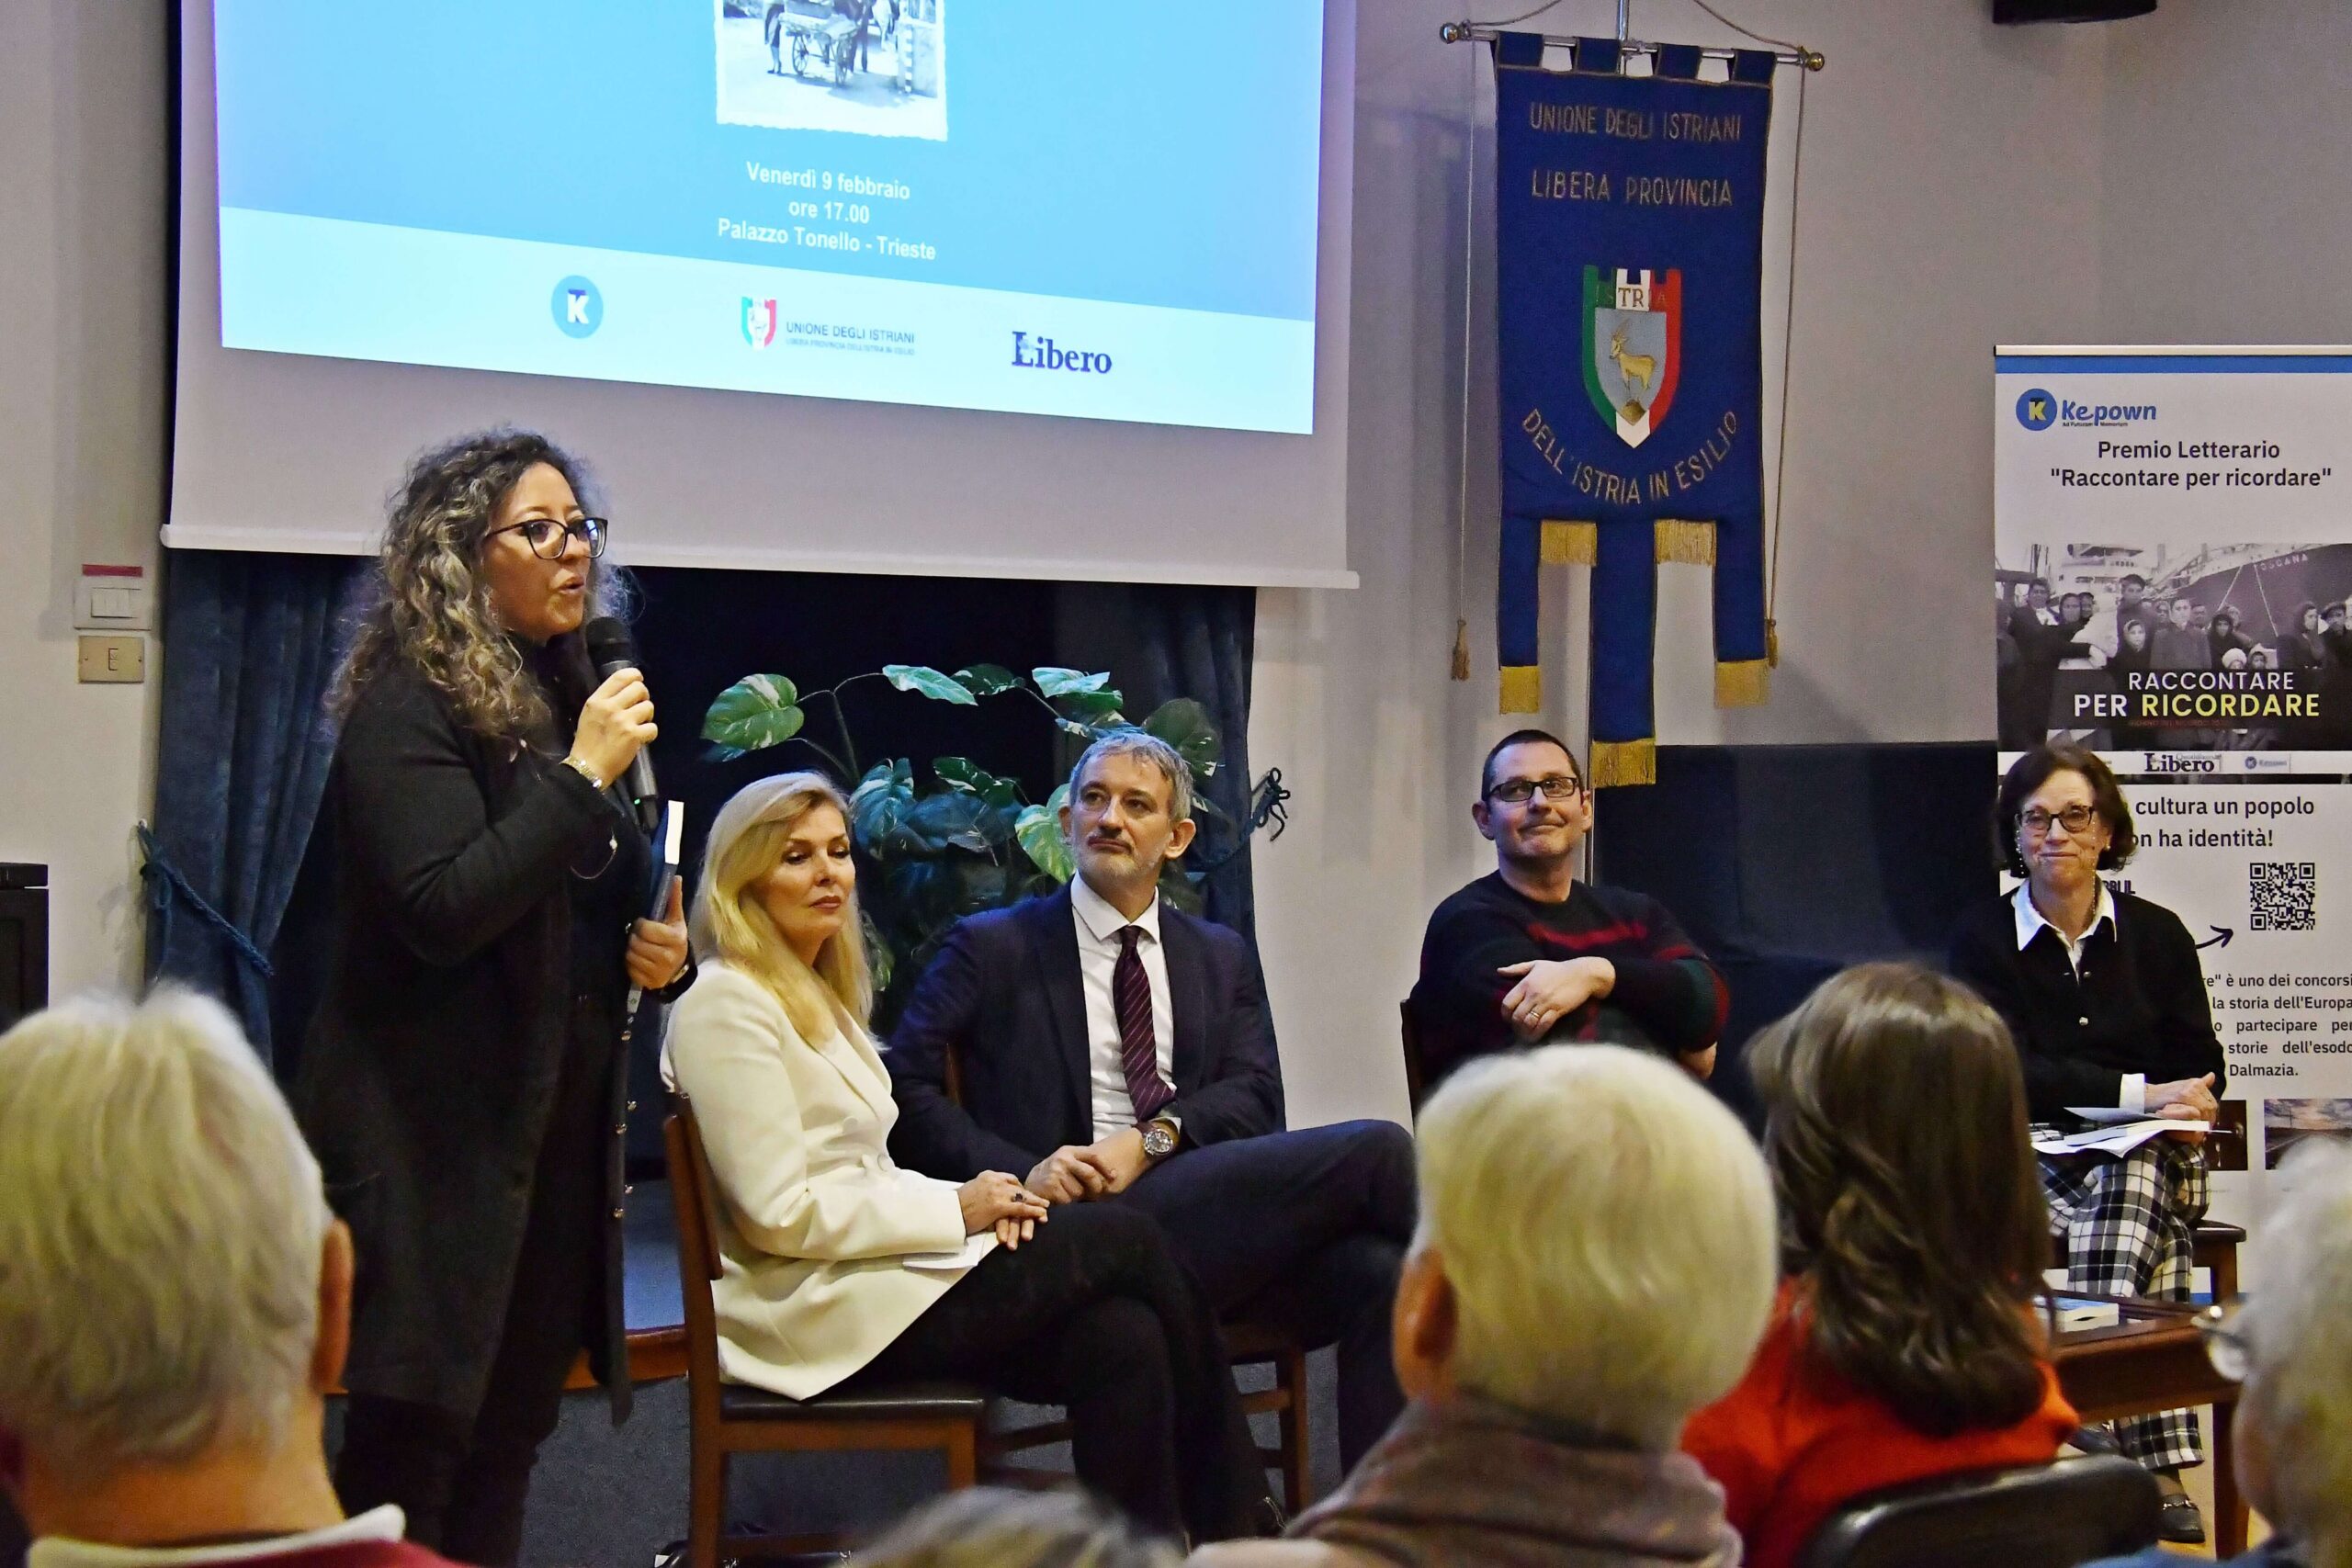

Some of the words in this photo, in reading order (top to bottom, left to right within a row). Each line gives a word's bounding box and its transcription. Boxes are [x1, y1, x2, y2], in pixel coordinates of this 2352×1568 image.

[1530, 102, 1598, 134] UNIONE
[1605, 107, 1653, 138] DEGLI
[1663, 112, 1741, 141] ISTRIANI
[746, 161, 816, 188] Venerdì
[822, 171, 832, 190] 9
[838, 173, 910, 199] febbraio
[1532, 170, 1610, 201] LIBERA
[1625, 177, 1733, 207] PROVINCIA
[788, 201, 818, 219] ore
[824, 201, 870, 224] 17.00
[718, 218, 788, 243] Palazzo
[794, 227, 860, 252] Tonello
[876, 236, 936, 260] Trieste
[786, 321, 828, 335] UNIONE
[833, 325, 865, 339] DEGLI
[869, 329, 915, 344] ISTRIANI
[1012, 331, 1113, 374] Libero
[1649, 470, 1669, 501] IN
[1675, 412, 1736, 490] ESILIO
[2098, 440, 2171, 458] Premio
[2178, 440, 2280, 458] Letterario
[2051, 468, 2179, 487] "Raccontare
[2186, 472, 2220, 490] per
[2225, 468, 2332, 487] ricordare"
[2129, 671, 2294, 691] RACCONTARE
[2075, 694, 2127, 717] PER
[2142, 694, 2320, 716] RICORDARE
[2144, 753, 2214, 772] Libero
[2136, 796, 2208, 814] cultura
[2214, 801, 2237, 814] un
[2245, 796, 2314, 818] popolo
[2159, 829, 2183, 847] ha
[2188, 829, 2273, 847] identità!
[2226, 974, 2234, 987] è
[2239, 976, 2264, 987] uno
[2269, 974, 2290, 987] dei
[2212, 997, 2224, 1009] la
[2229, 997, 2269, 1009] storia
[2236, 1019, 2317, 1034] partecipare
[2228, 1042, 2267, 1054] storie
[2230, 1065, 2299, 1077] Dalmazia.
